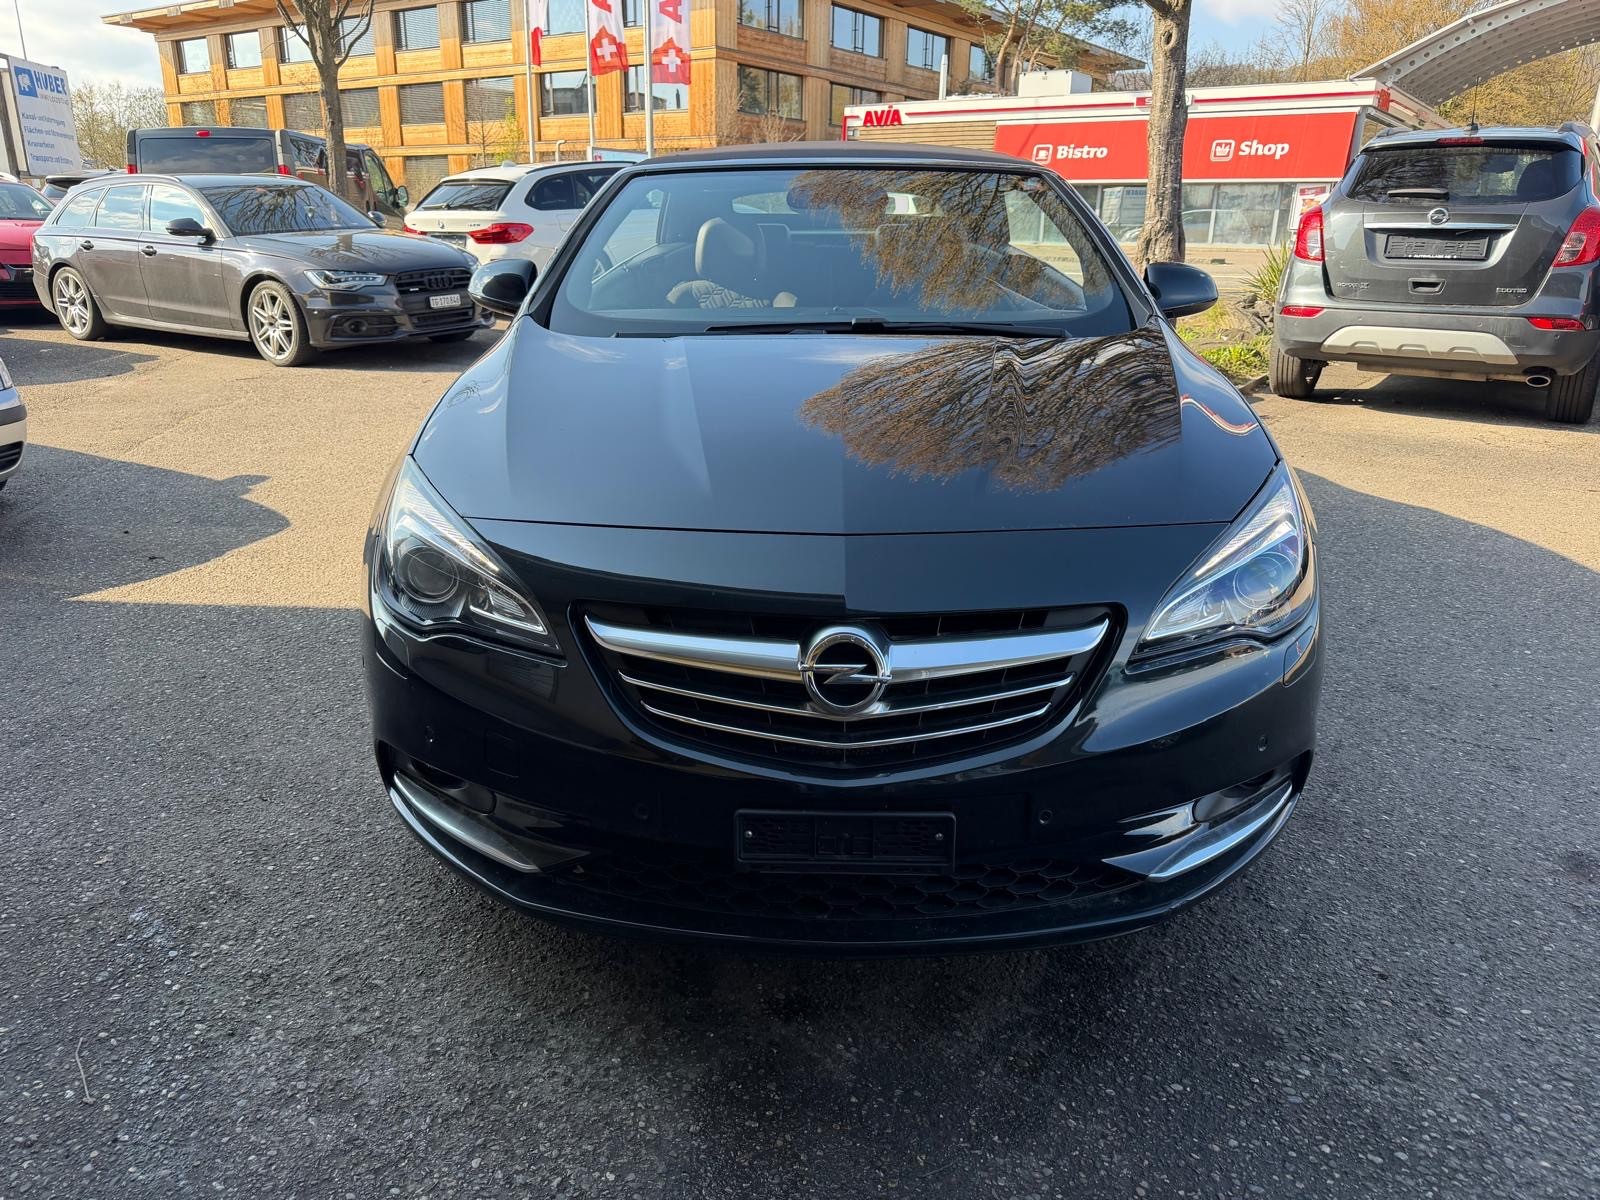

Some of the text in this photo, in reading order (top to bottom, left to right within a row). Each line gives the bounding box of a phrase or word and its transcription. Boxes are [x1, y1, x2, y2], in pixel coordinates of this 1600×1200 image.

[33, 70, 67, 95] HUBER
[863, 105, 903, 127] AVIA
[1057, 145, 1108, 160] Bistro
[1239, 140, 1290, 160] Shop
